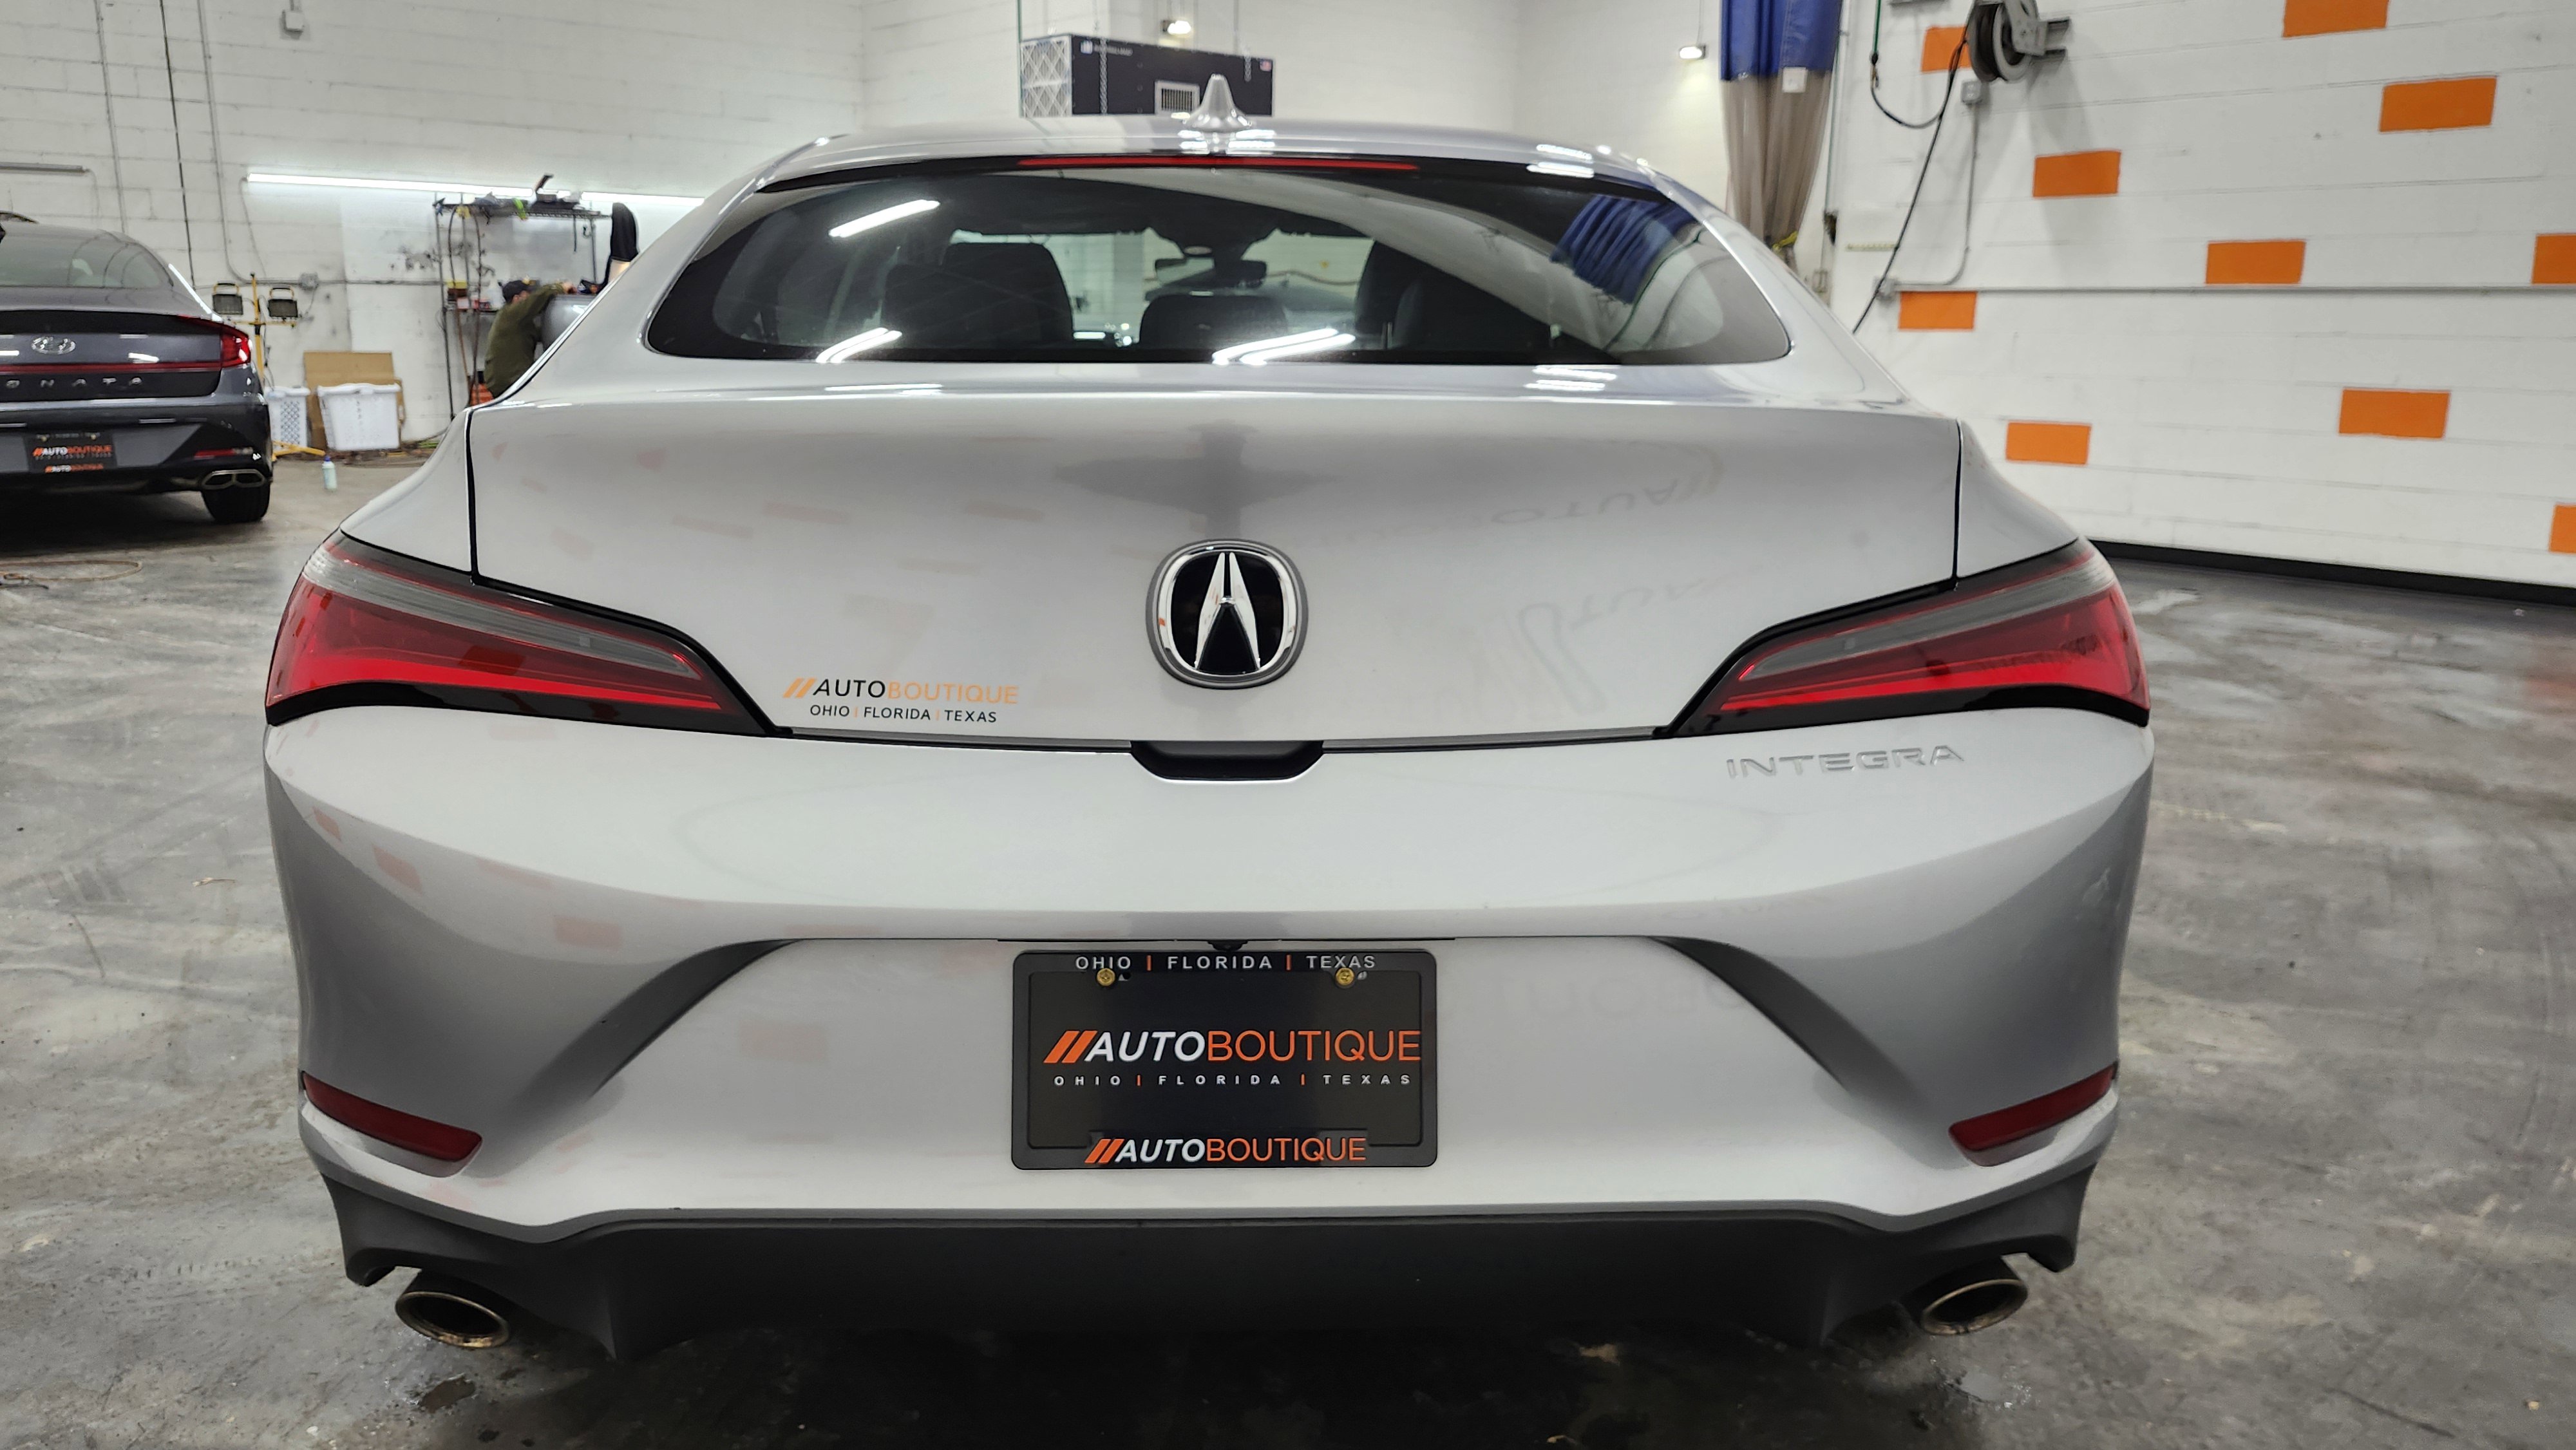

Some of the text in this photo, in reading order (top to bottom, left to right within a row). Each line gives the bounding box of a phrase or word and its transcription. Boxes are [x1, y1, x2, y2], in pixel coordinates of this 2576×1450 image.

[813, 678, 1019, 705] AUTOBOUTIQUE
[810, 704, 997, 723] OHIO FLORIDA TEXAS
[1726, 744, 1965, 778] INTEGRA
[1075, 955, 1376, 970] OHIO FLORIDA TEXAS
[1083, 1030, 1422, 1062] AUTOBOUTIQUE
[1054, 1074, 1411, 1086] OHIO FLORIDA TEXAS
[1114, 1138, 1367, 1162] AUTOBOUTIQUE
